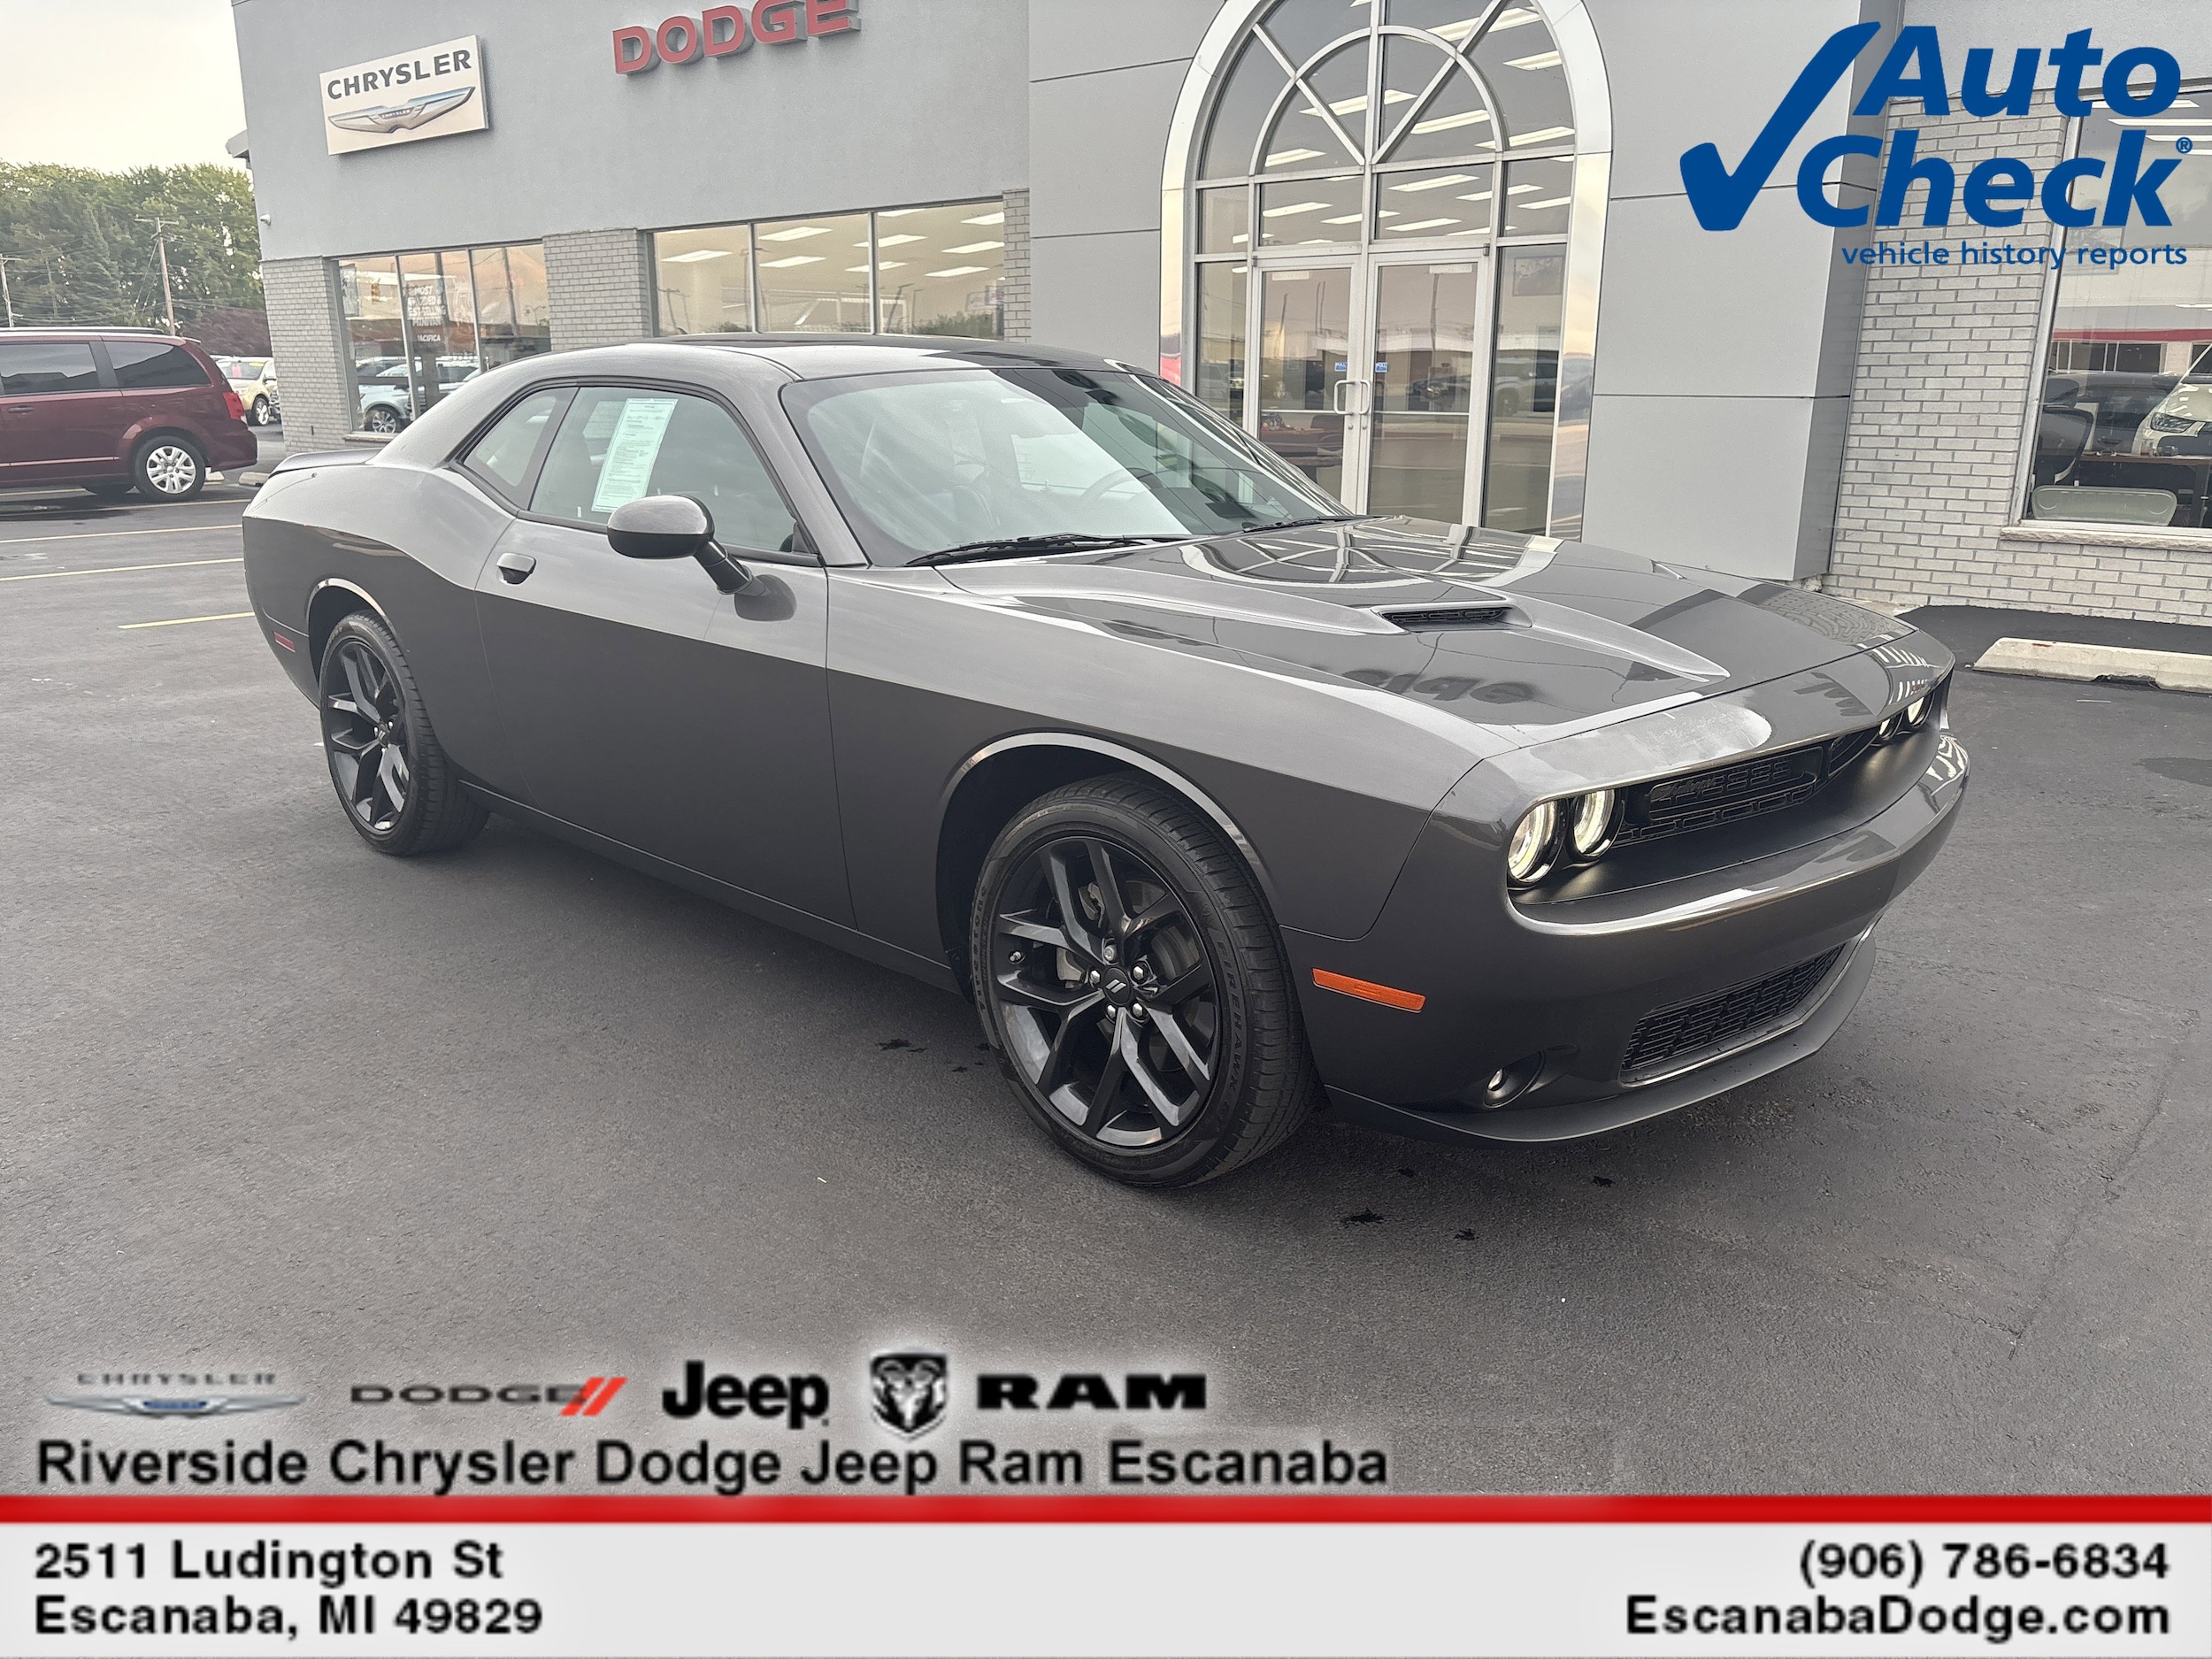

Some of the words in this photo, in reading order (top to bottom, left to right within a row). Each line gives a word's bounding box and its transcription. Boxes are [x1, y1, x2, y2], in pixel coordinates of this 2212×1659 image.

[612, 0, 861, 74] DODGE
[327, 50, 472, 100] CHRYSLER
[1216, 940, 1243, 1091] FIREHAWK
